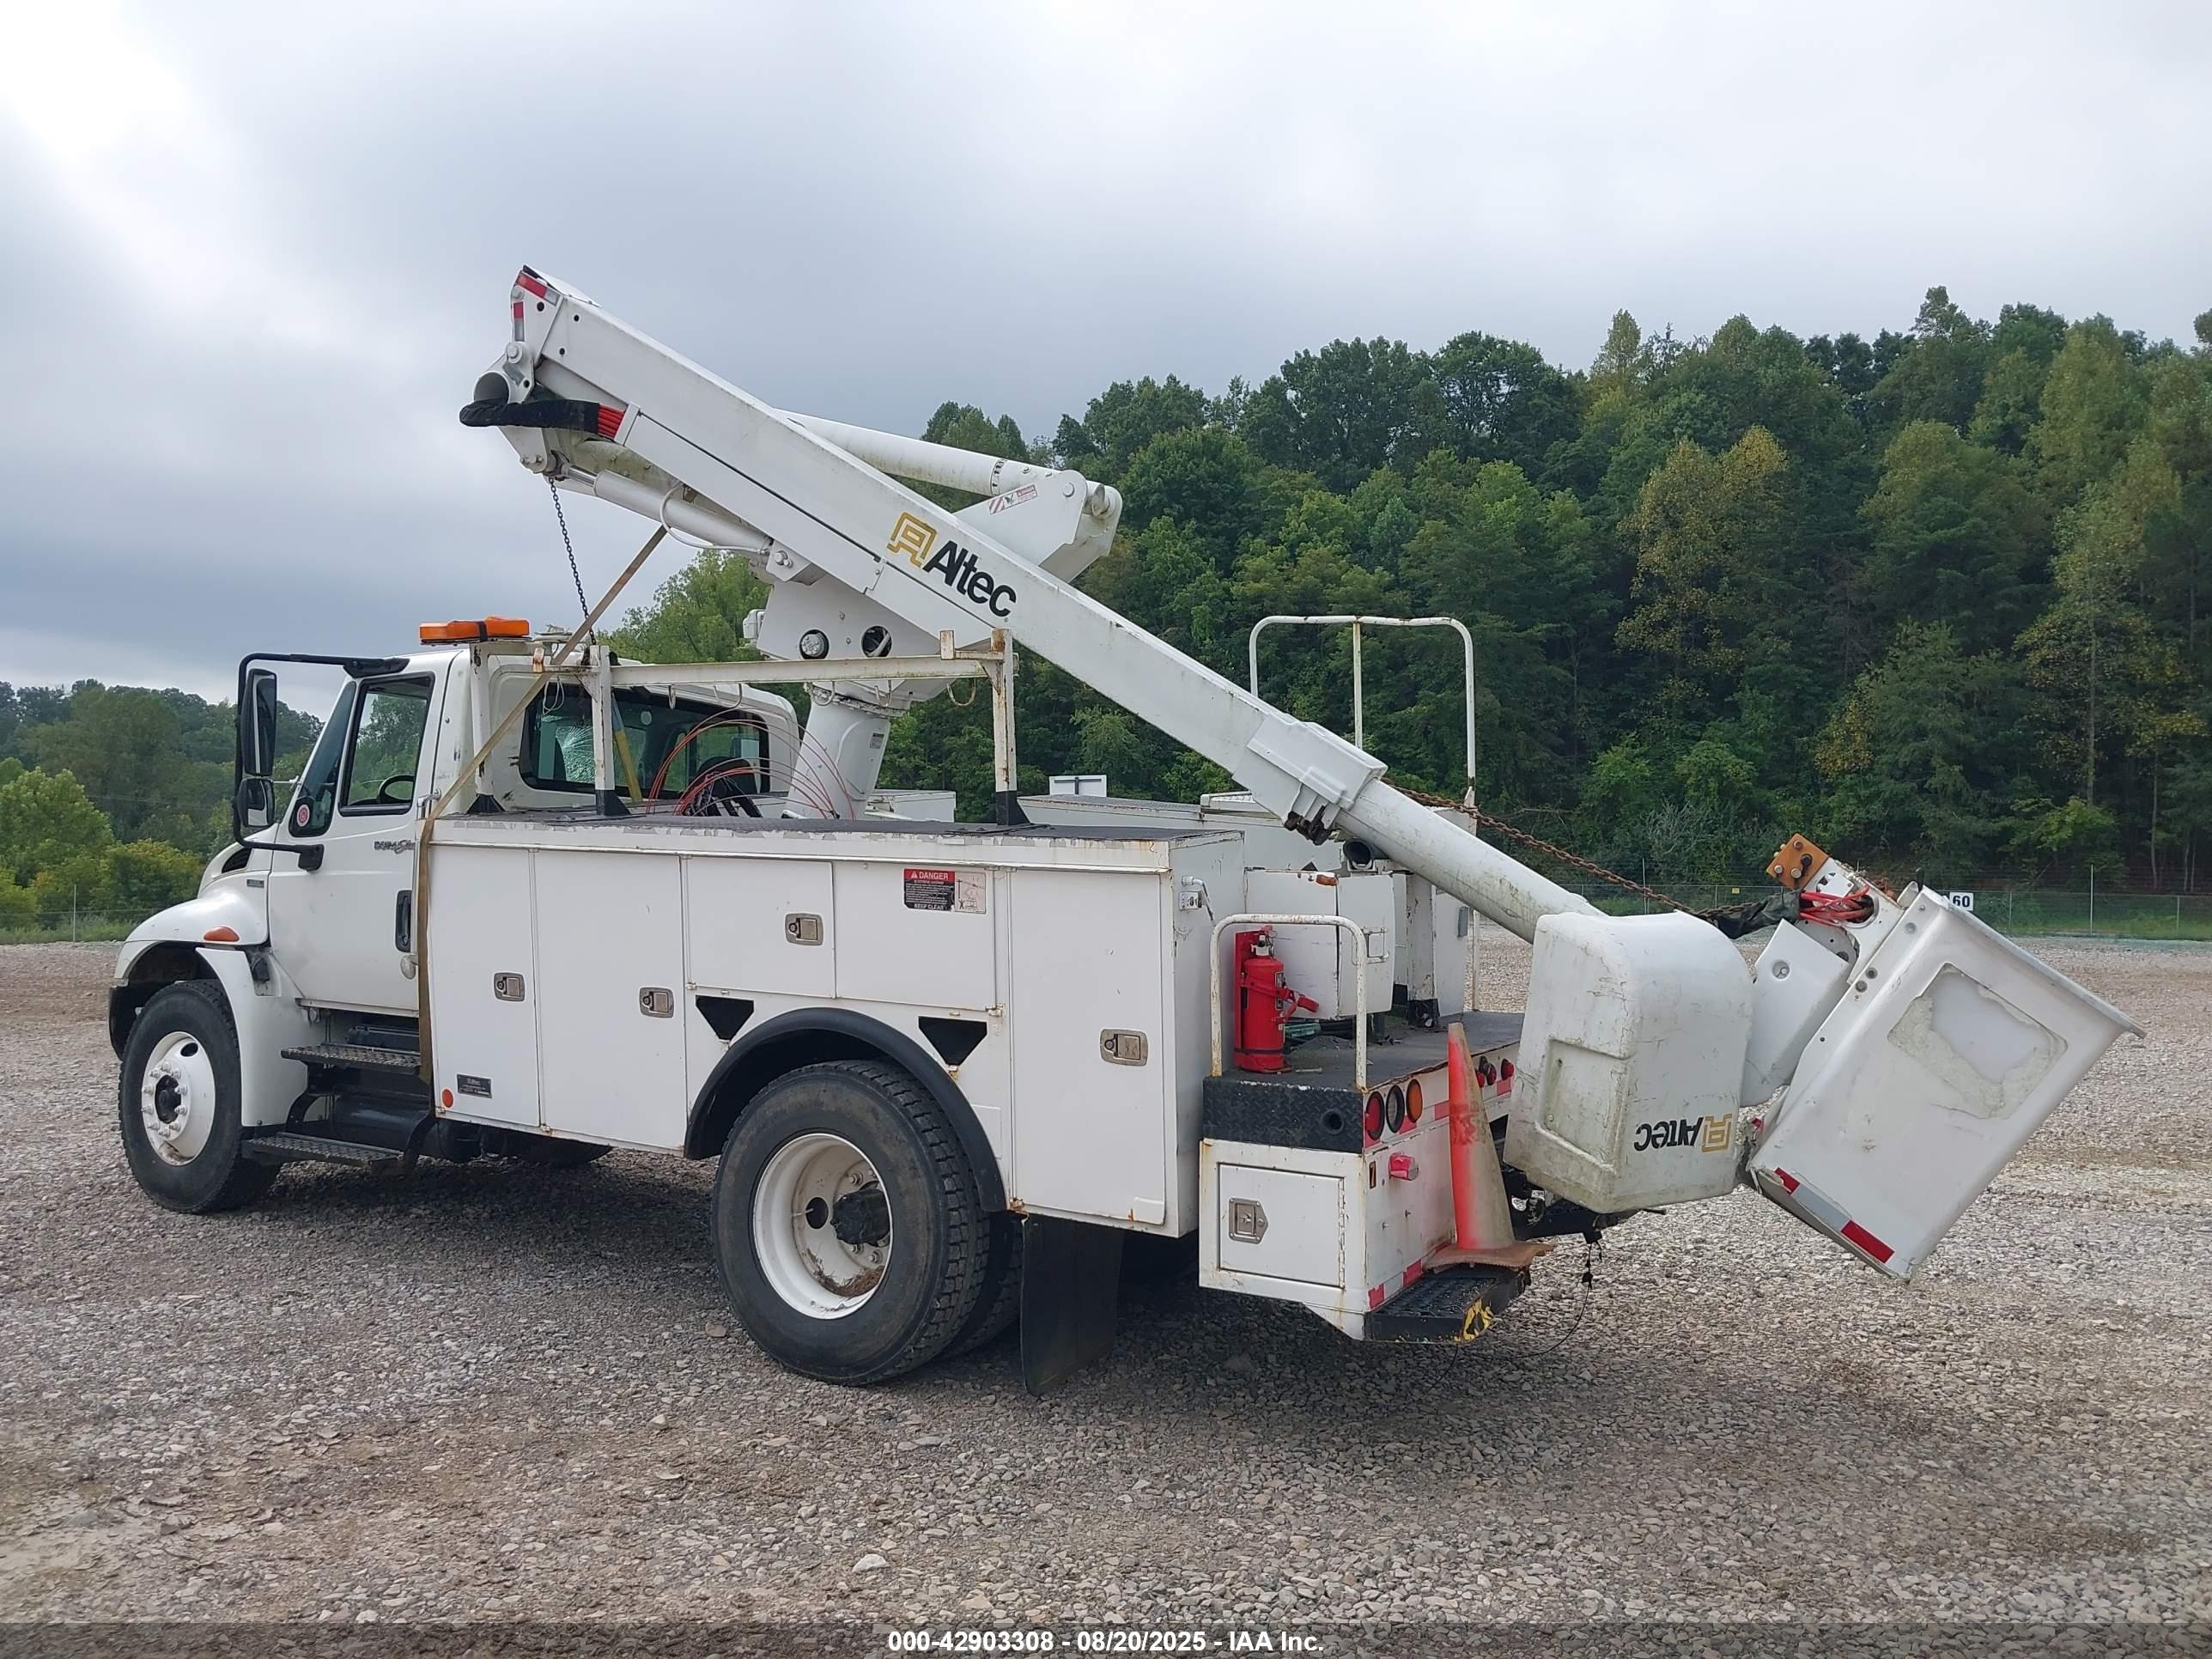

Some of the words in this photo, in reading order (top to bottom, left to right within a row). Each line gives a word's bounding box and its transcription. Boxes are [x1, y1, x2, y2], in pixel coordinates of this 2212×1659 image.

[922, 539, 1017, 617] Altec
[919, 871, 949, 880] DANGER
[1953, 895, 1971, 908] 60
[1634, 1116, 1704, 1152] Altec
